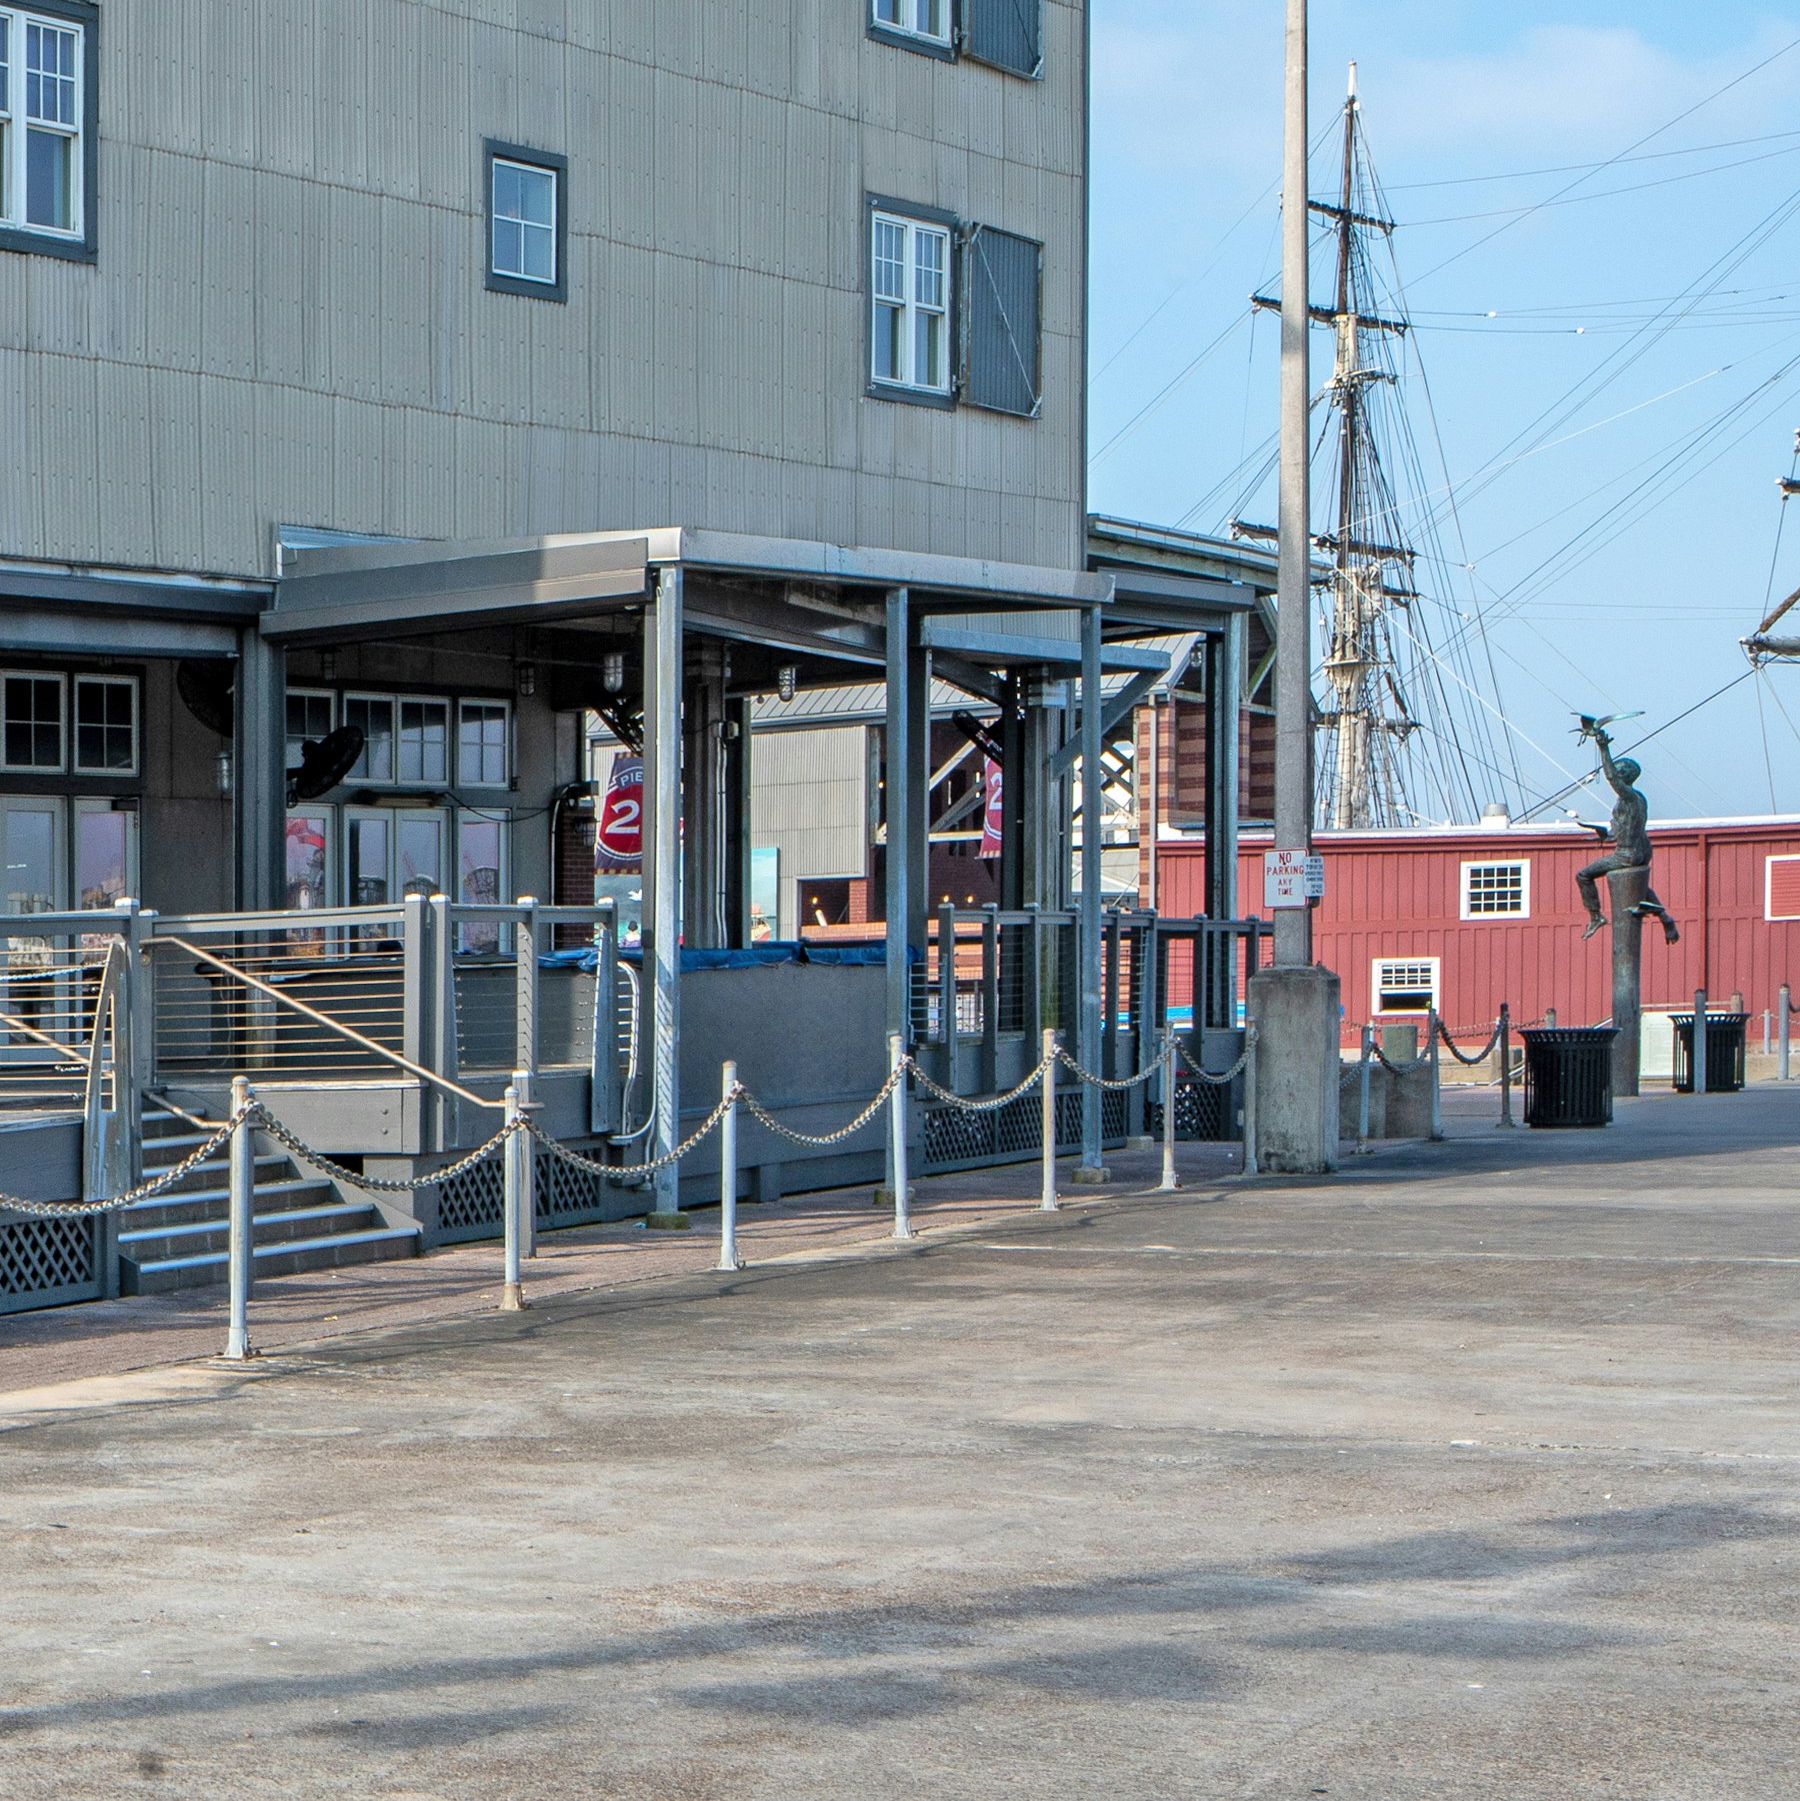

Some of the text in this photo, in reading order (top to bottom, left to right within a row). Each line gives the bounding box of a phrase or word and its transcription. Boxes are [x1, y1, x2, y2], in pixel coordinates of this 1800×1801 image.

[620, 771, 643, 787] PIE
[988, 772, 1003, 810] 2
[605, 799, 640, 834] 2
[1278, 852, 1292, 864] NO
[1266, 865, 1304, 876] PARKING
[1278, 888, 1293, 896] TIME
